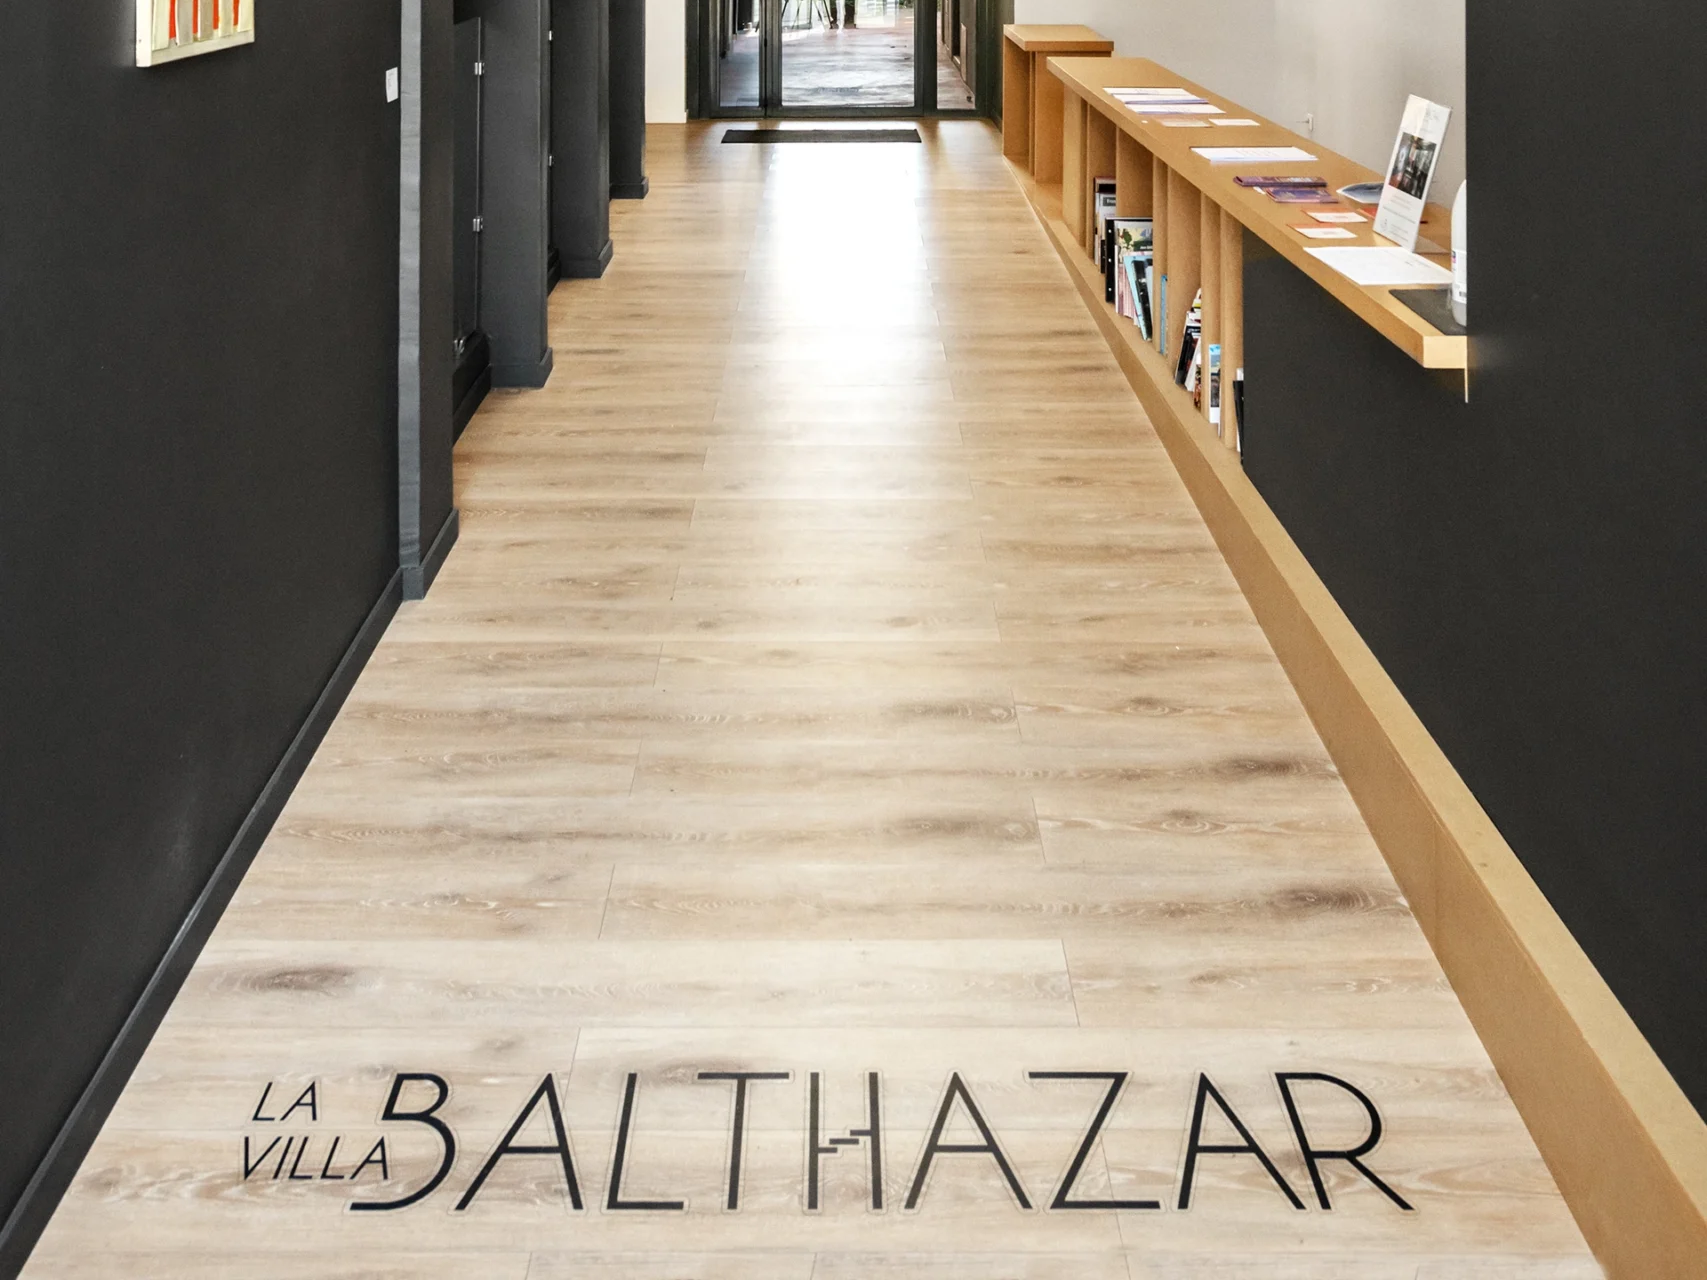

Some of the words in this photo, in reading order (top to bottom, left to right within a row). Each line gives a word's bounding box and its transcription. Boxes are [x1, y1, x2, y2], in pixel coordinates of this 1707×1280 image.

[252, 1081, 317, 1121] LA
[244, 1136, 388, 1180] VILLA
[350, 1072, 1415, 1210] BALTHAZAR
